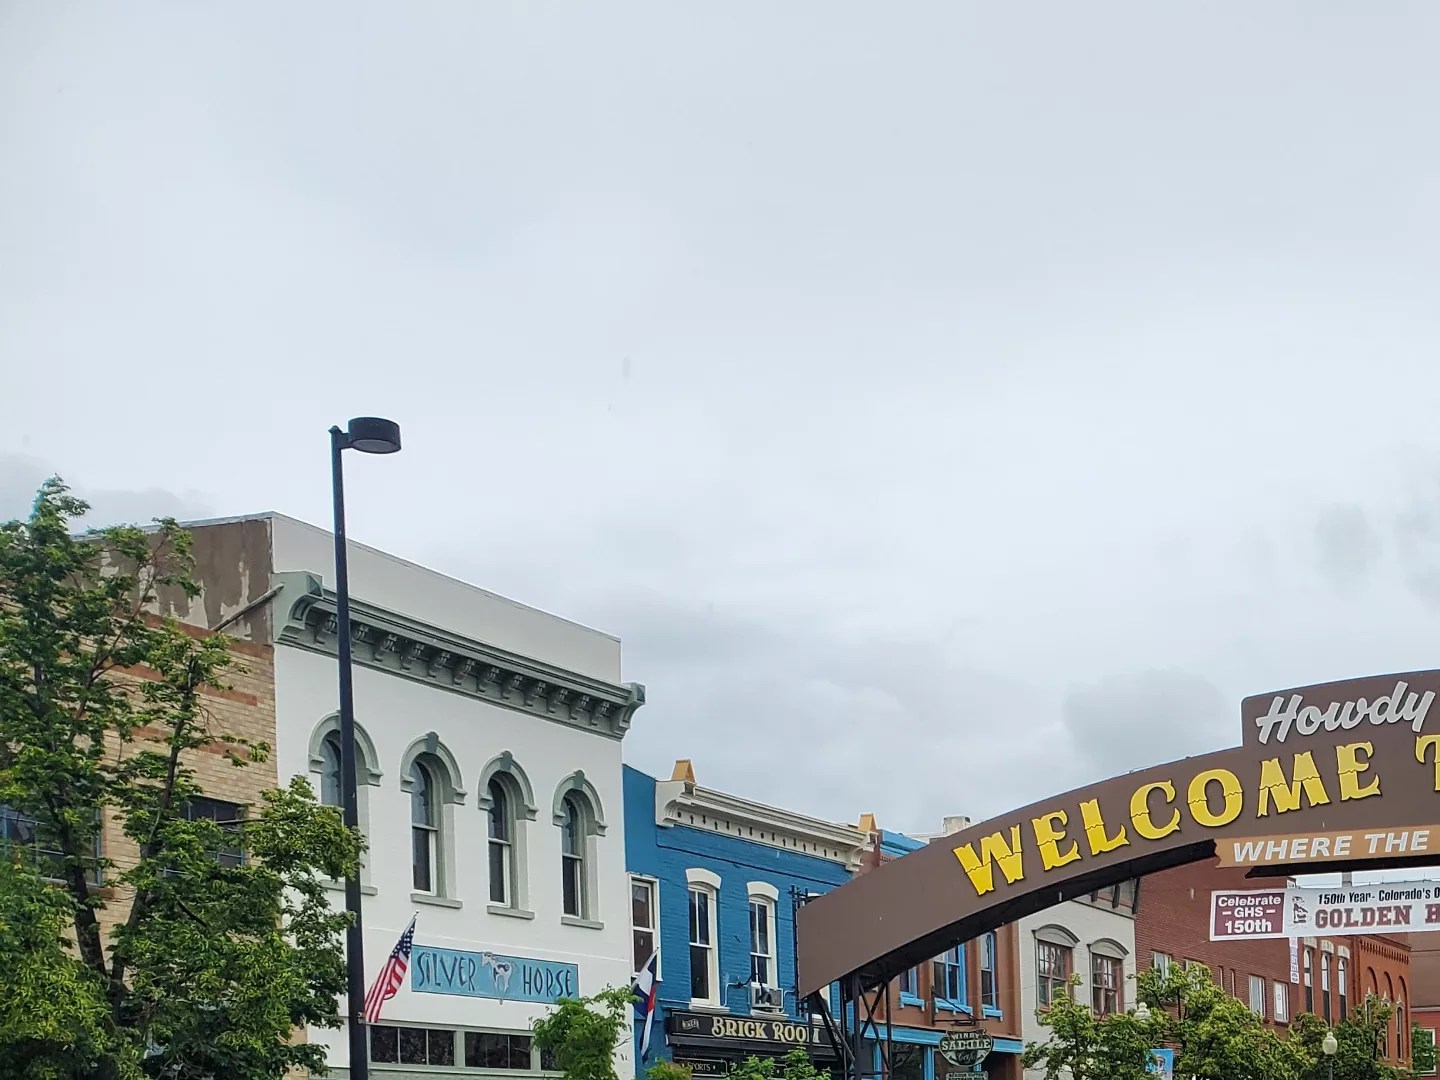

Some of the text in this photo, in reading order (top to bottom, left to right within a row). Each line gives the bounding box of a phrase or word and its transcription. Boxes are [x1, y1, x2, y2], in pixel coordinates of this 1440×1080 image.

[1256, 680, 1436, 744] Howdy
[952, 741, 1381, 896] WELCOME
[1233, 832, 1361, 864] WHERE
[1366, 827, 1430, 857] THE
[1218, 895, 1281, 907] Celebrate
[1318, 893, 1345, 905] 150th
[1349, 891, 1376, 904] Year-
[1379, 888, 1431, 902] Colorado's
[1234, 906, 1264, 918] GHS
[1315, 904, 1412, 929] GOLDEN
[1225, 918, 1272, 934] 150th
[522, 964, 574, 998] HORSE
[711, 1016, 769, 1039] BRICK
[772, 1022, 821, 1043] ROOM
[687, 1061, 710, 1071] SPORTS
